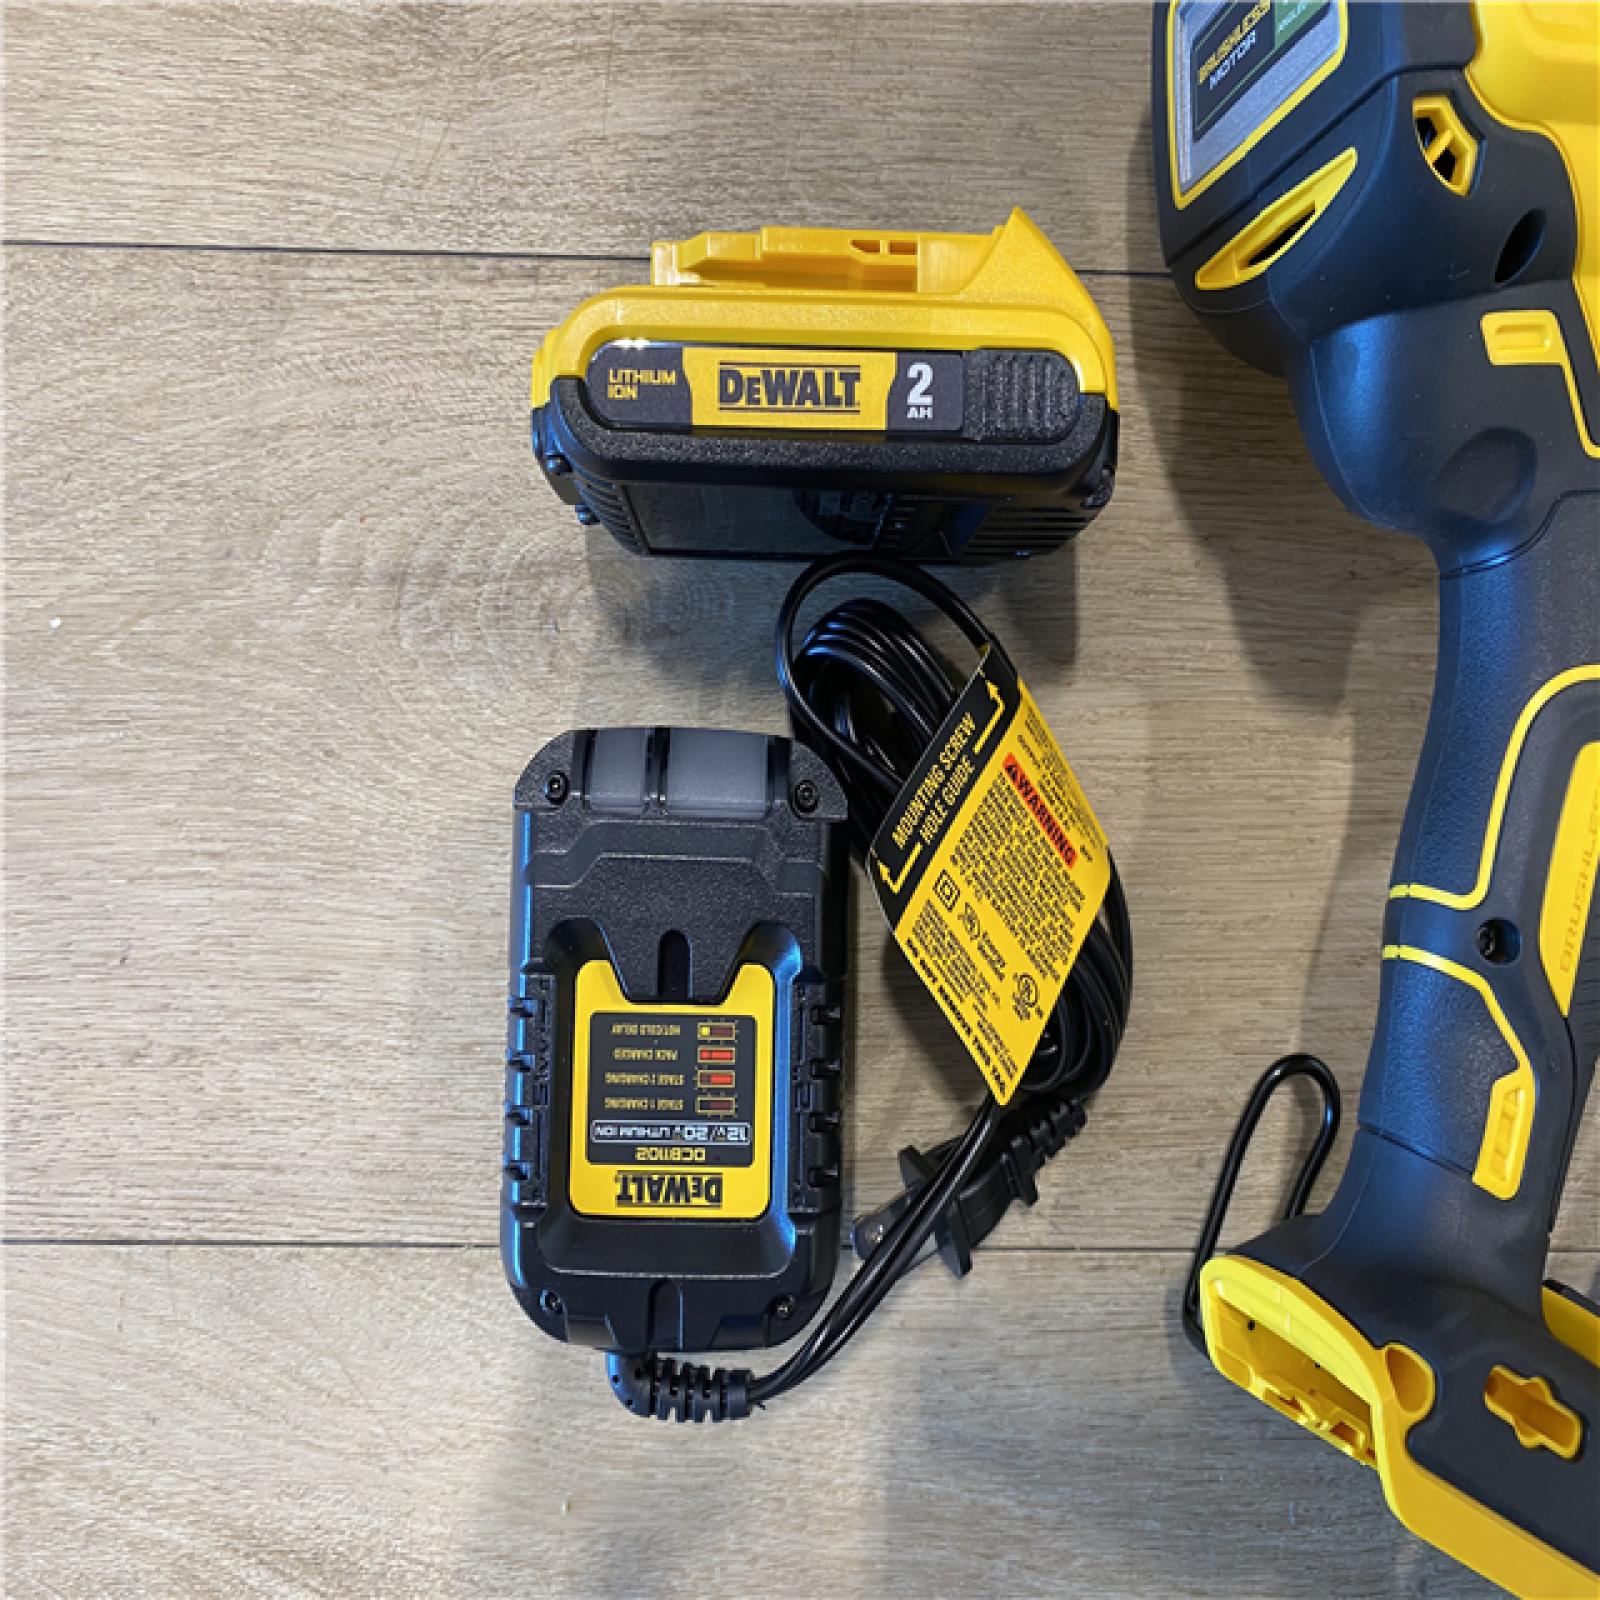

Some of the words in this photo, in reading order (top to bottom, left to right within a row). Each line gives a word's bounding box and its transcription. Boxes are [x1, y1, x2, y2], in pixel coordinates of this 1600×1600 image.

[1209, 29, 1256, 91] MOTOR
[608, 369, 677, 386] LITHIUM
[906, 362, 934, 405] 2
[606, 384, 638, 400] ION
[906, 404, 934, 419] AH
[892, 764, 945, 850] MOUNTING
[940, 712, 975, 770] SCREW
[920, 800, 948, 845] HOLE
[942, 754, 975, 805] GUIDE
[1018, 774, 1075, 865] WARNING
[595, 1124, 618, 1136] ION
[619, 1125, 671, 1136] LITHIUM
[635, 1147, 706, 1161] DCB1102
